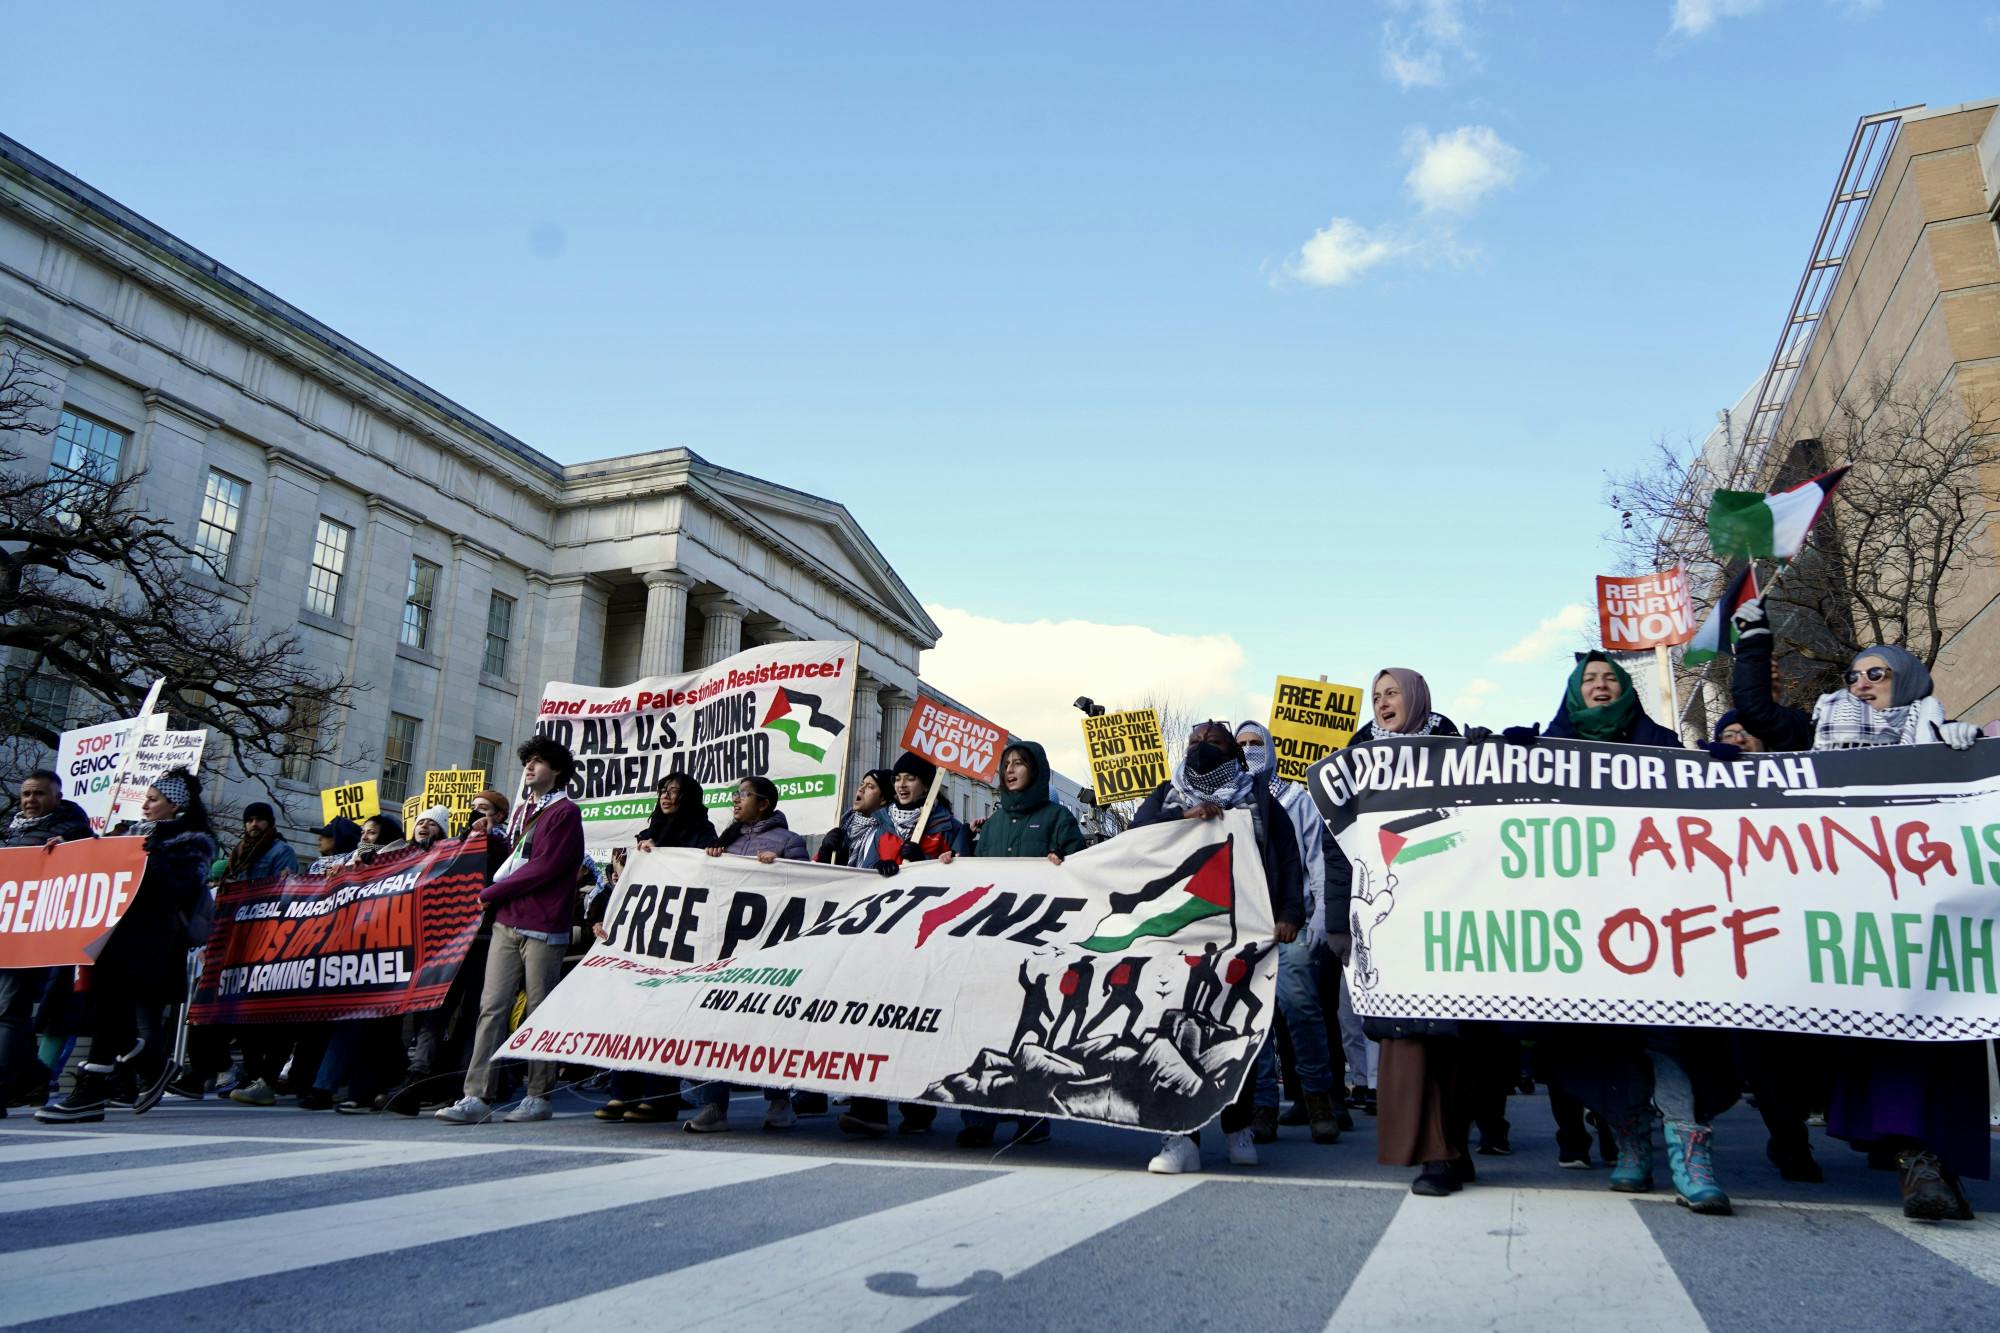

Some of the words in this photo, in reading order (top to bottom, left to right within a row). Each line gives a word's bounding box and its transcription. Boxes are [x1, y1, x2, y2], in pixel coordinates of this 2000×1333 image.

[1609, 604, 1694, 643] NOW
[540, 698, 586, 715] tand
[588, 696, 631, 714] with
[636, 678, 724, 711] Palestinian
[727, 658, 844, 690] Resistance!
[1278, 684, 1323, 710] FREE
[1324, 692, 1357, 716] ALL
[579, 718, 628, 755] ALL
[635, 711, 684, 751] U.S.
[692, 690, 757, 747] FUNDING
[918, 716, 994, 757] UNRWA
[922, 704, 1000, 742] REFUND
[1085, 714, 1123, 730] STAND
[1125, 710, 1155, 723] WITH
[1088, 721, 1158, 742] PALESTINE!
[1275, 706, 1355, 733] PALESTINIAN
[75, 734, 112, 756] STOP
[188, 751, 194, 761] A
[911, 729, 993, 774] NOW
[1090, 738, 1126, 759] END
[1129, 732, 1162, 752] THE
[1093, 751, 1164, 773] OCCUPATION
[74, 779, 88, 797] IN
[113, 772, 131, 785] WE
[428, 772, 457, 783] STAND
[460, 772, 481, 782] WITH
[428, 782, 481, 794] PALESTINE!
[1096, 763, 1166, 796] NOW!
[1319, 745, 1434, 807] GLOBAL
[1441, 743, 1580, 790] MARCH
[1591, 751, 1668, 791] FOR
[1676, 755, 1818, 790] RAFAH
[334, 785, 364, 807] END
[338, 805, 365, 821] ALL
[427, 794, 450, 809] END
[1500, 816, 1616, 879] STOP
[1629, 814, 1957, 901] ARMING
[0, 871, 133, 933] GENOCIDE
[235, 902, 282, 921] GLOBAL
[285, 896, 337, 918] MARCH
[335, 885, 359, 909] FOR
[357, 872, 422, 898] RAFAH
[281, 913, 333, 960] OFF
[319, 893, 413, 955] RAFAH
[601, 883, 709, 962] FREE
[1424, 908, 1583, 974] HANDS
[1598, 904, 1780, 979] OFF
[1804, 910, 1998, 994] RAFAH
[218, 968, 248, 996] STOP
[248, 958, 315, 993] ARMING
[318, 951, 412, 988] ISRAEL
[700, 988, 736, 1011] END
[735, 992, 771, 1014] ALL
[772, 994, 802, 1018] US
[801, 998, 835, 1023] AID
[843, 1001, 868, 1024] TO
[870, 1003, 942, 1033] ISRAEL
[509, 1027, 533, 1050] @
[531, 1029, 889, 1082] PALESTINIANYOUTHMOVEMENT
